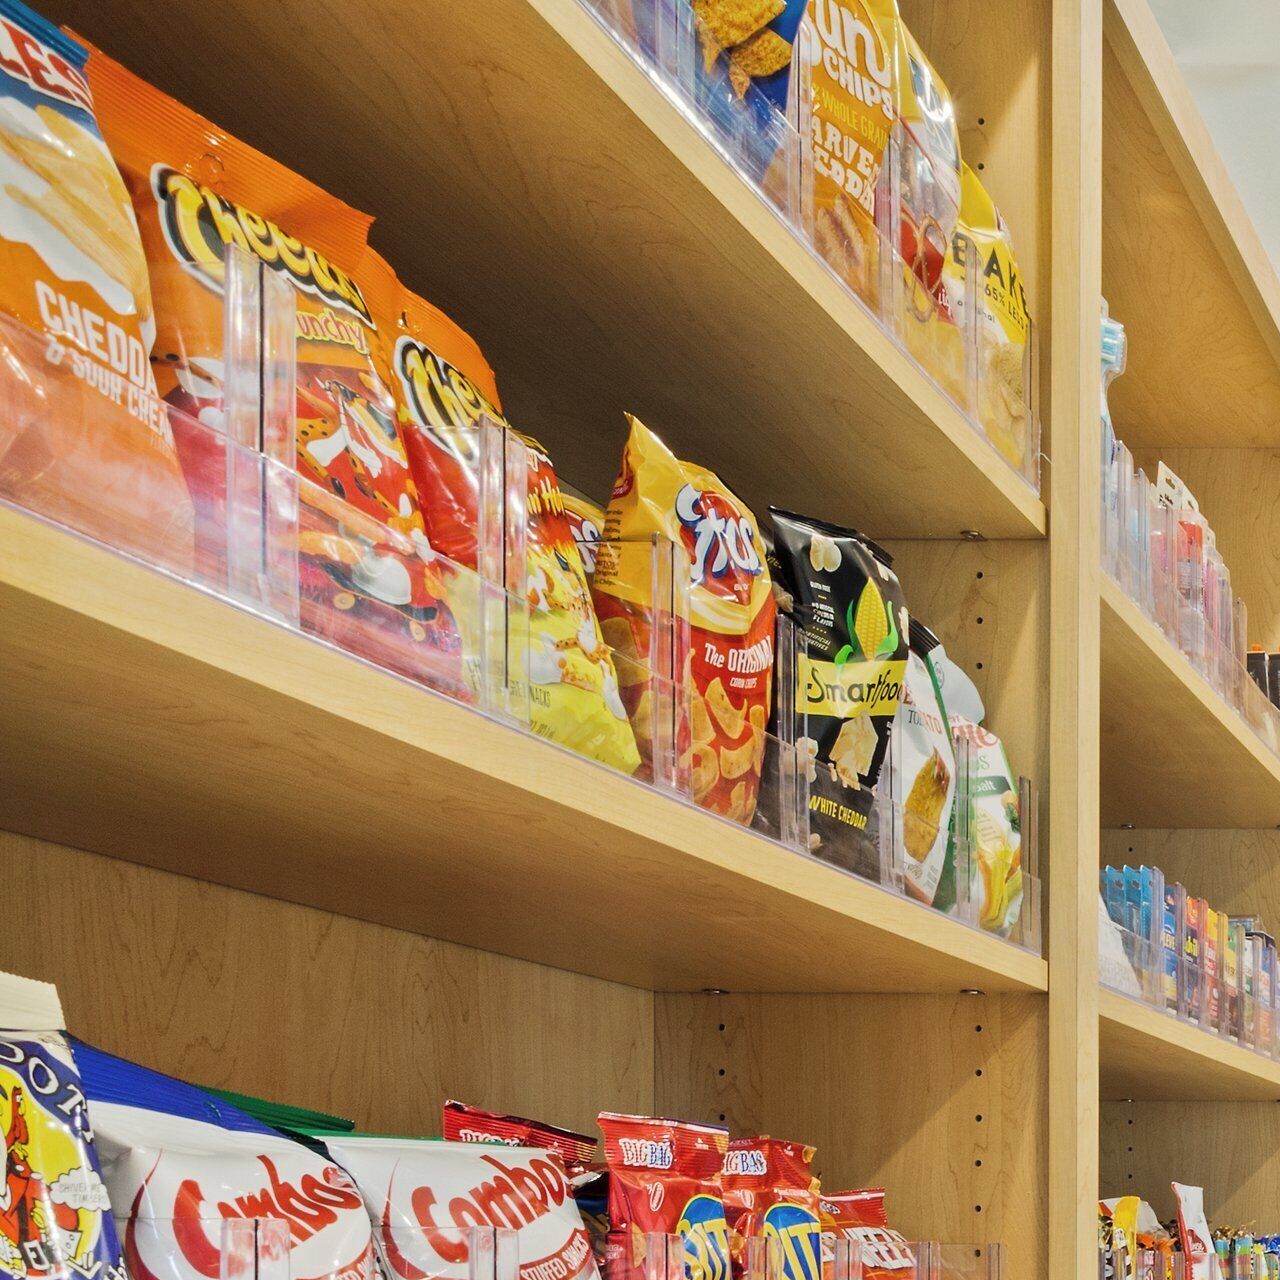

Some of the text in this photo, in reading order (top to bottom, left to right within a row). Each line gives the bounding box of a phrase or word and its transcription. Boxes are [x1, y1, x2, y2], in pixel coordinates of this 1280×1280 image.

[822, 47, 894, 120] CHIPS
[821, 89, 859, 131] WHOLE
[984, 283, 1006, 307] 65%
[34, 279, 160, 399] CHEDDA
[296, 306, 370, 354] unchy
[70, 352, 122, 405] SOUR
[705, 635, 774, 674] The ORIGINAL
[529, 684, 551, 708] NACKS
[808, 795, 868, 831] WHITE CHEDDAR
[622, 1139, 647, 1165] BIG
[722, 1150, 741, 1174] IG
[561, 1231, 590, 1271] SNACKS
